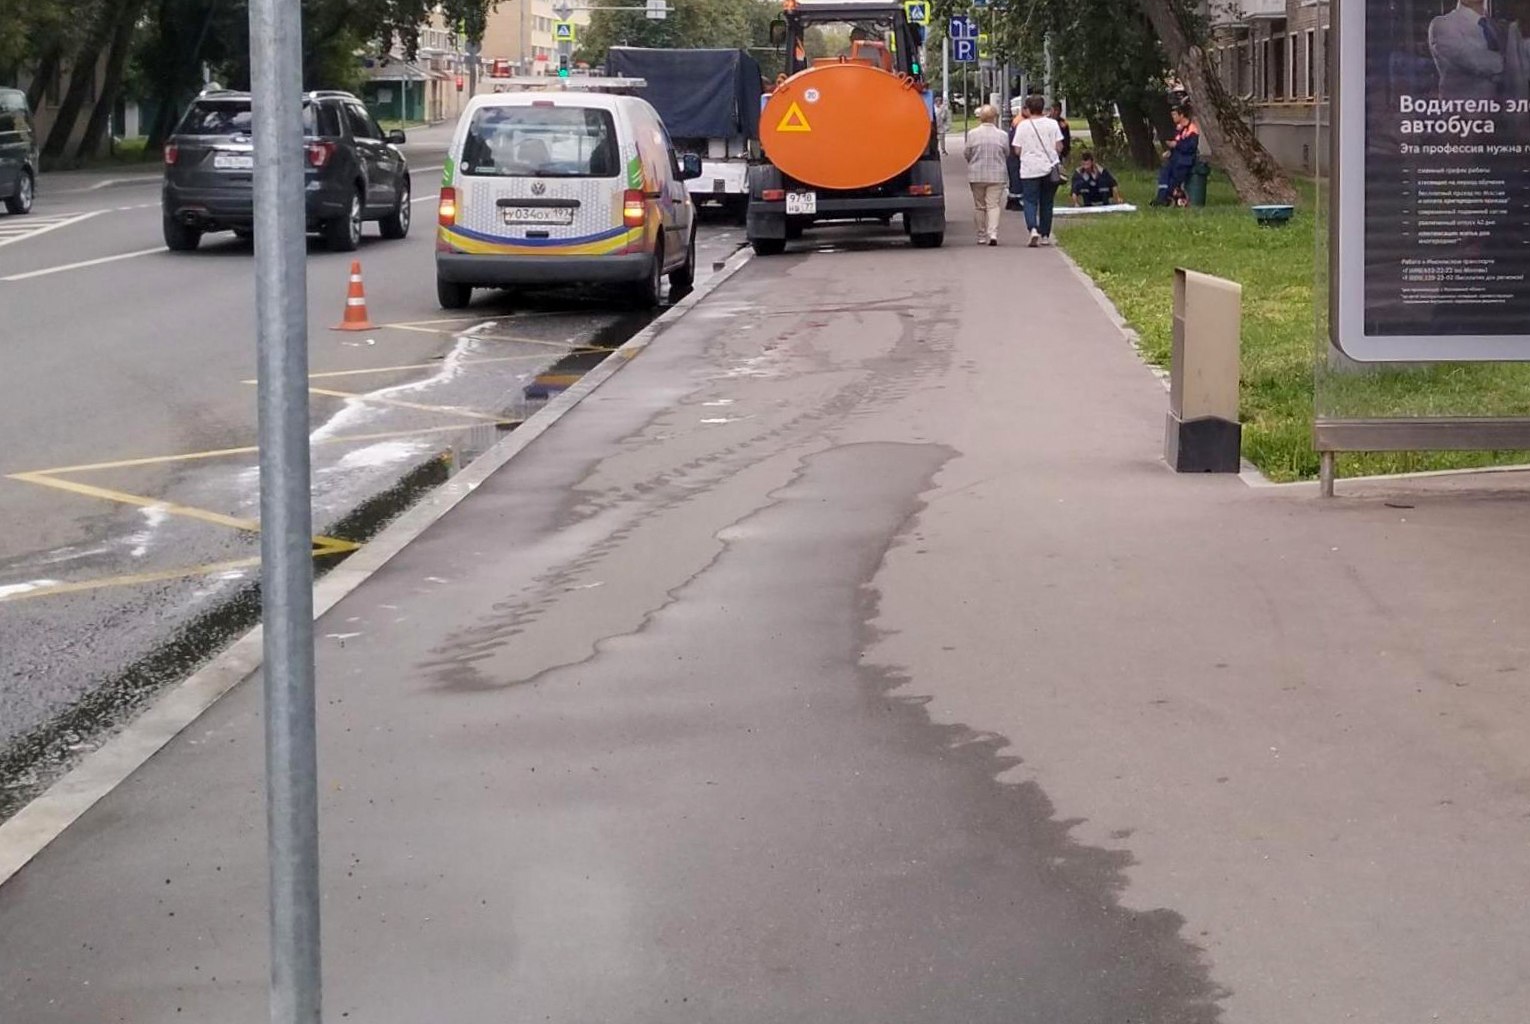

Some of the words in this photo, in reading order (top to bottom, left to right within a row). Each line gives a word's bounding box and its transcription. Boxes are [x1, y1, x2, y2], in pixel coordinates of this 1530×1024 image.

[1399, 94, 1501, 115] Водитель
[1400, 115, 1495, 137] автобуса
[1400, 143, 1420, 154] Эта
[1422, 143, 1484, 155] профессия
[1486, 144, 1521, 155] нужна
